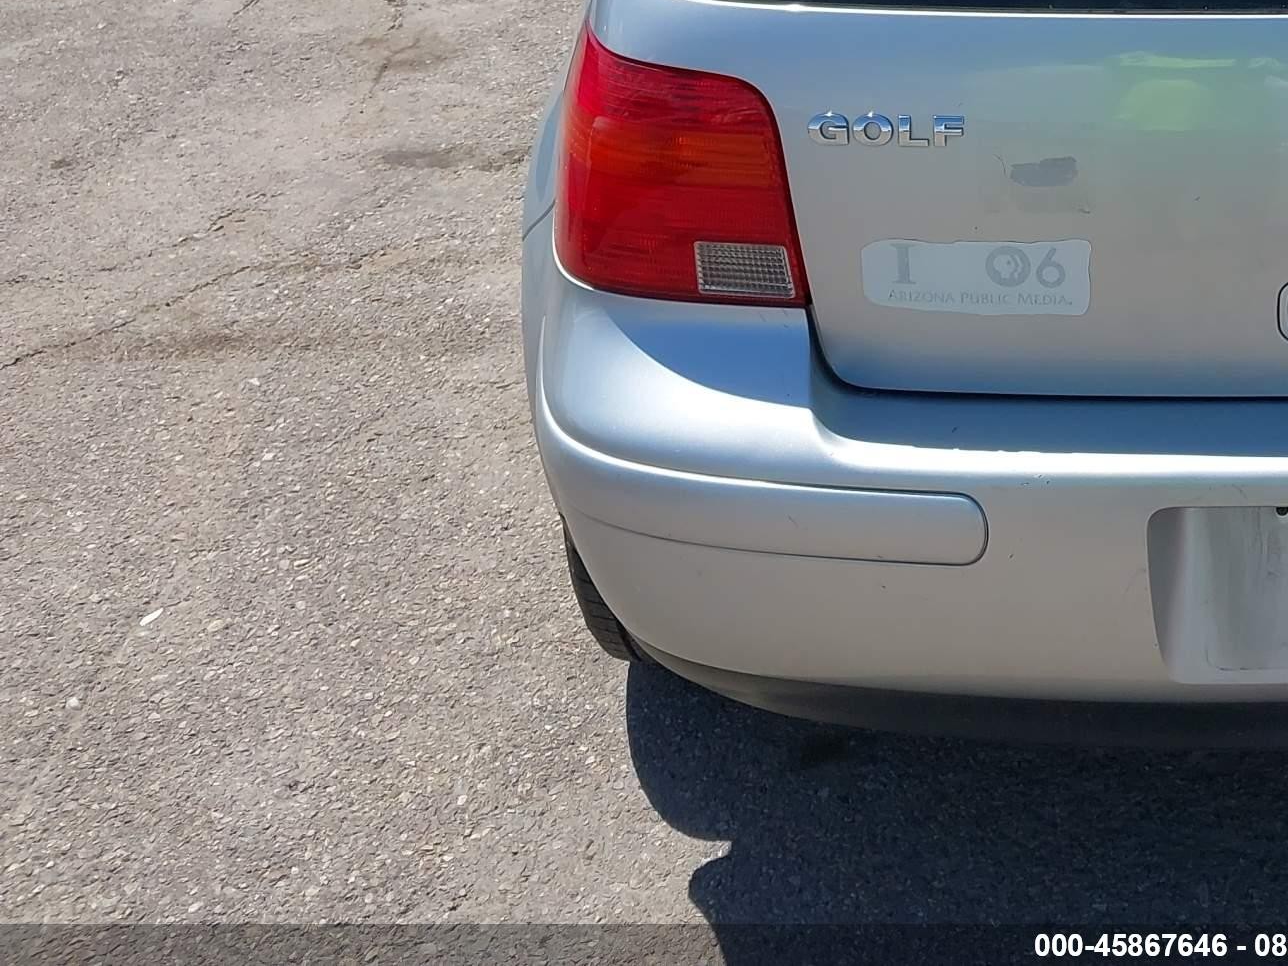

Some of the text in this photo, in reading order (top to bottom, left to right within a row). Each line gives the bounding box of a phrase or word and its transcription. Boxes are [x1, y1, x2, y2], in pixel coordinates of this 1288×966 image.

[807, 110, 965, 147] GOLF
[1035, 247, 1066, 288] 6
[887, 288, 955, 305] ARIZONA
[960, 291, 1009, 305] PUBLIC
